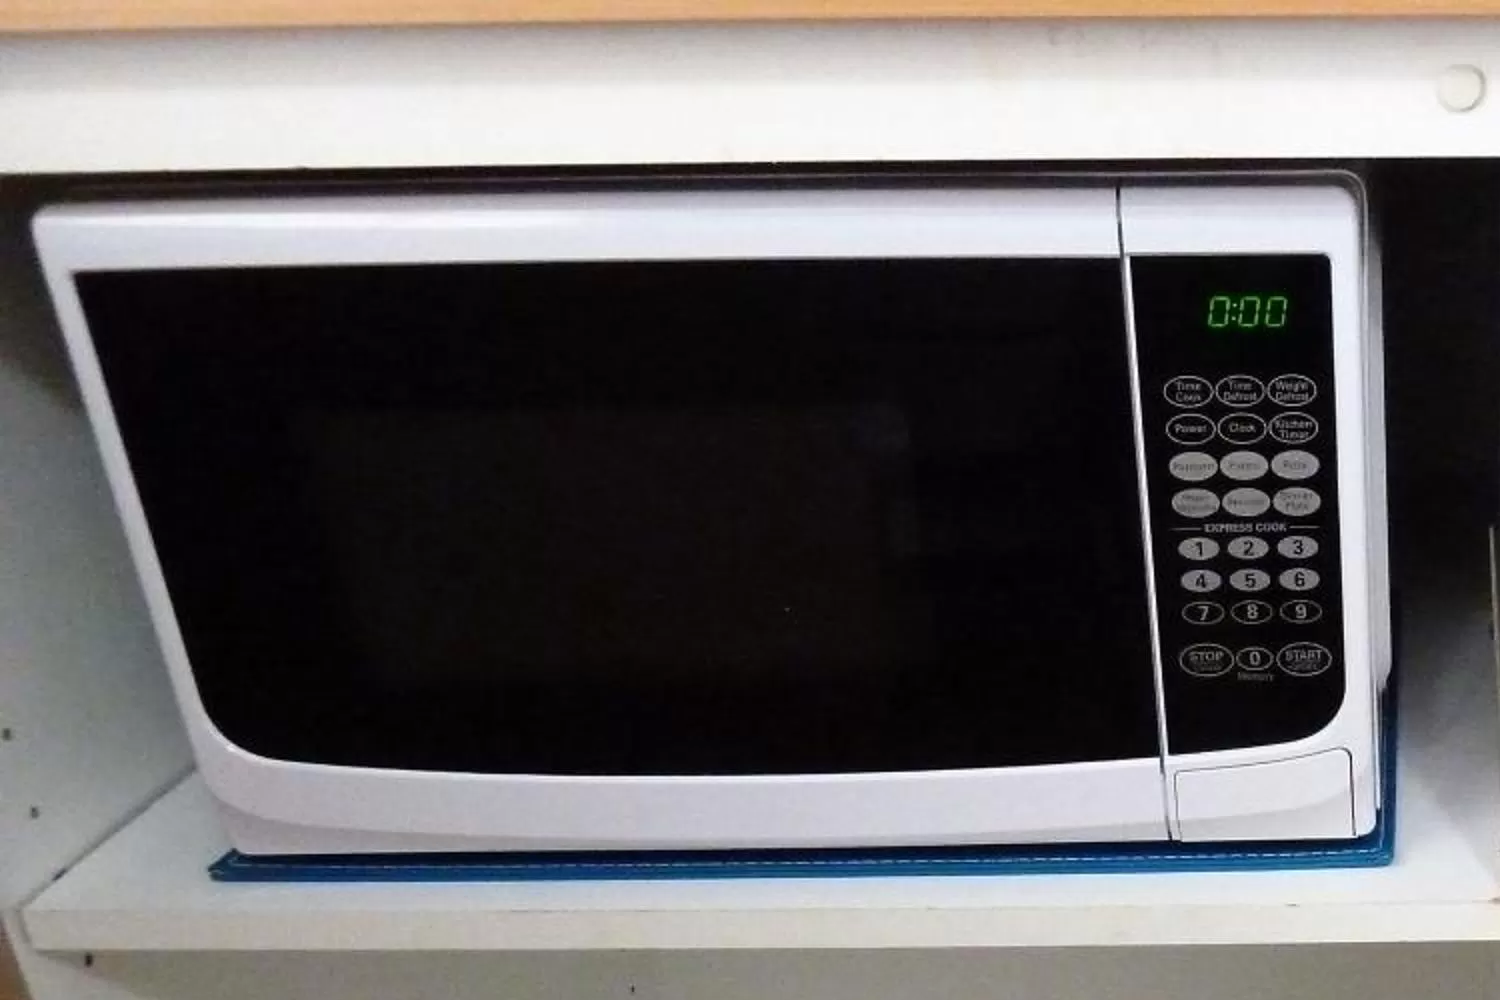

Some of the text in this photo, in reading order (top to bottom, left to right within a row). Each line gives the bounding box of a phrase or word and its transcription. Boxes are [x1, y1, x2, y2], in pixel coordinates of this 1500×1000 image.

[1207, 295, 1289, 328] 0:00
[1194, 541, 1204, 556] 1
[1242, 540, 1255, 556] 2
[1292, 539, 1304, 555] 3
[1194, 573, 1207, 589] 4
[1244, 573, 1257, 589] 5
[1293, 572, 1306, 588] 6
[1198, 605, 1210, 621] 7
[1246, 604, 1260, 620] 8
[1294, 603, 1308, 620] 9
[1189, 651, 1225, 662] STOP
[1249, 651, 1262, 666] 0
[1285, 649, 1323, 661] START
